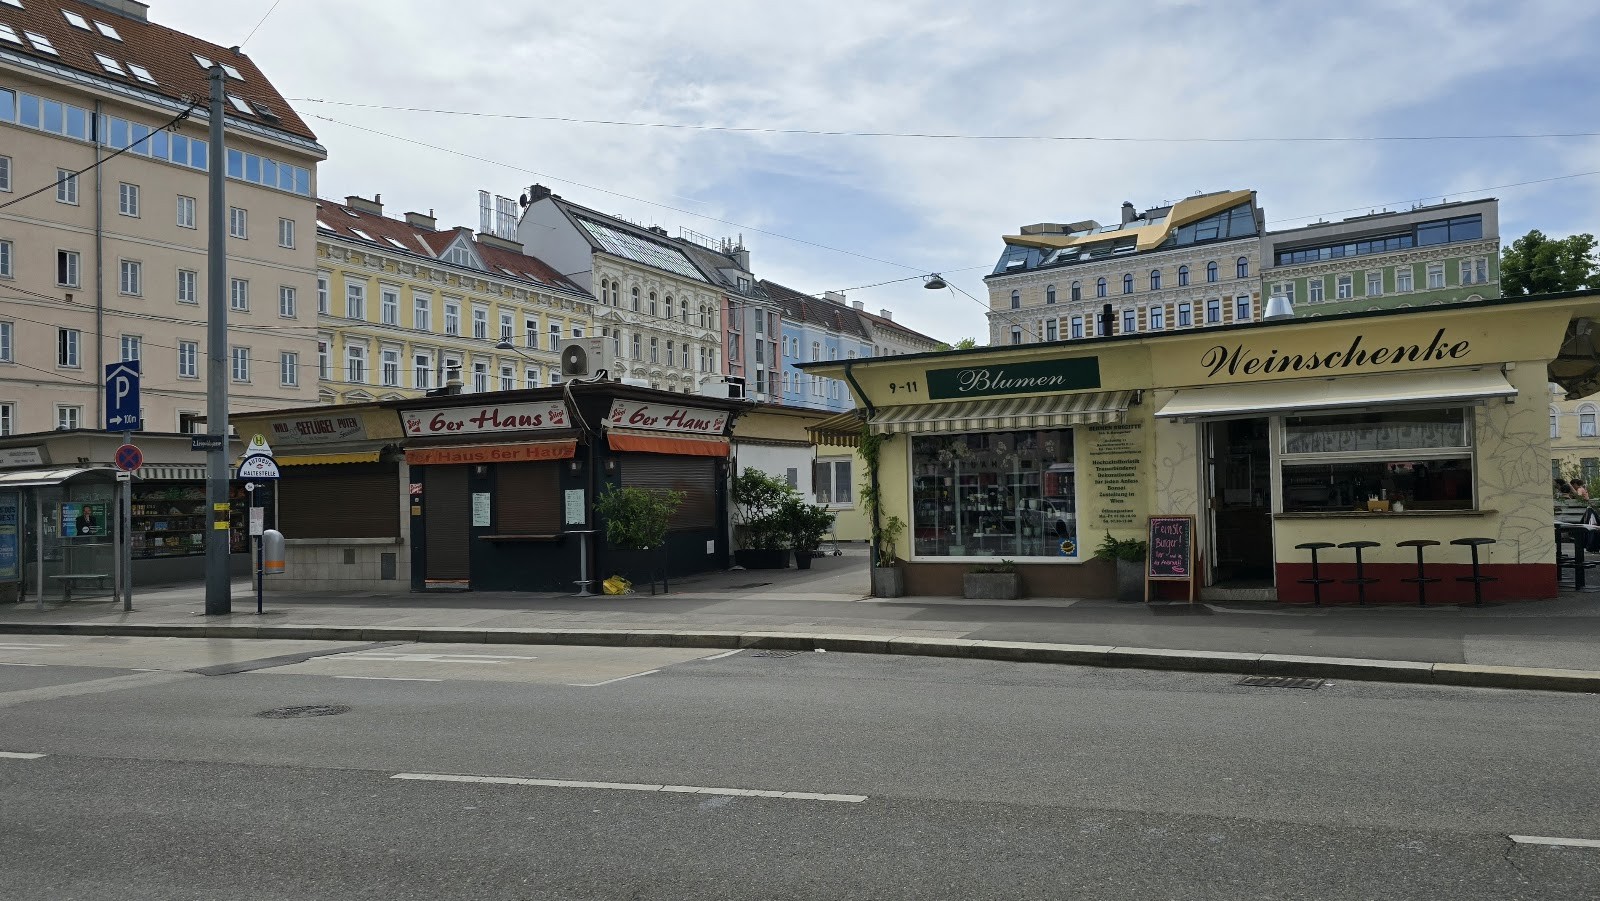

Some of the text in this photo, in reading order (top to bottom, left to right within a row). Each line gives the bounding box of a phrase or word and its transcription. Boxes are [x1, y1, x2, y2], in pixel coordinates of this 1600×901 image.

[1200, 328, 1471, 377] Weinschenke
[889, 381, 917, 394] 9-11
[956, 369, 1066, 392] Blumen
[116, 376, 130, 409] P
[273, 417, 358, 435] WILD GEFLÜGEL PUTEN
[429, 408, 542, 431] 6er Haus
[629, 405, 711, 430] 6er Haus
[248, 457, 273, 467] AUTOBUS
[438, 450, 485, 462] Haus
[490, 448, 520, 460] 6er
